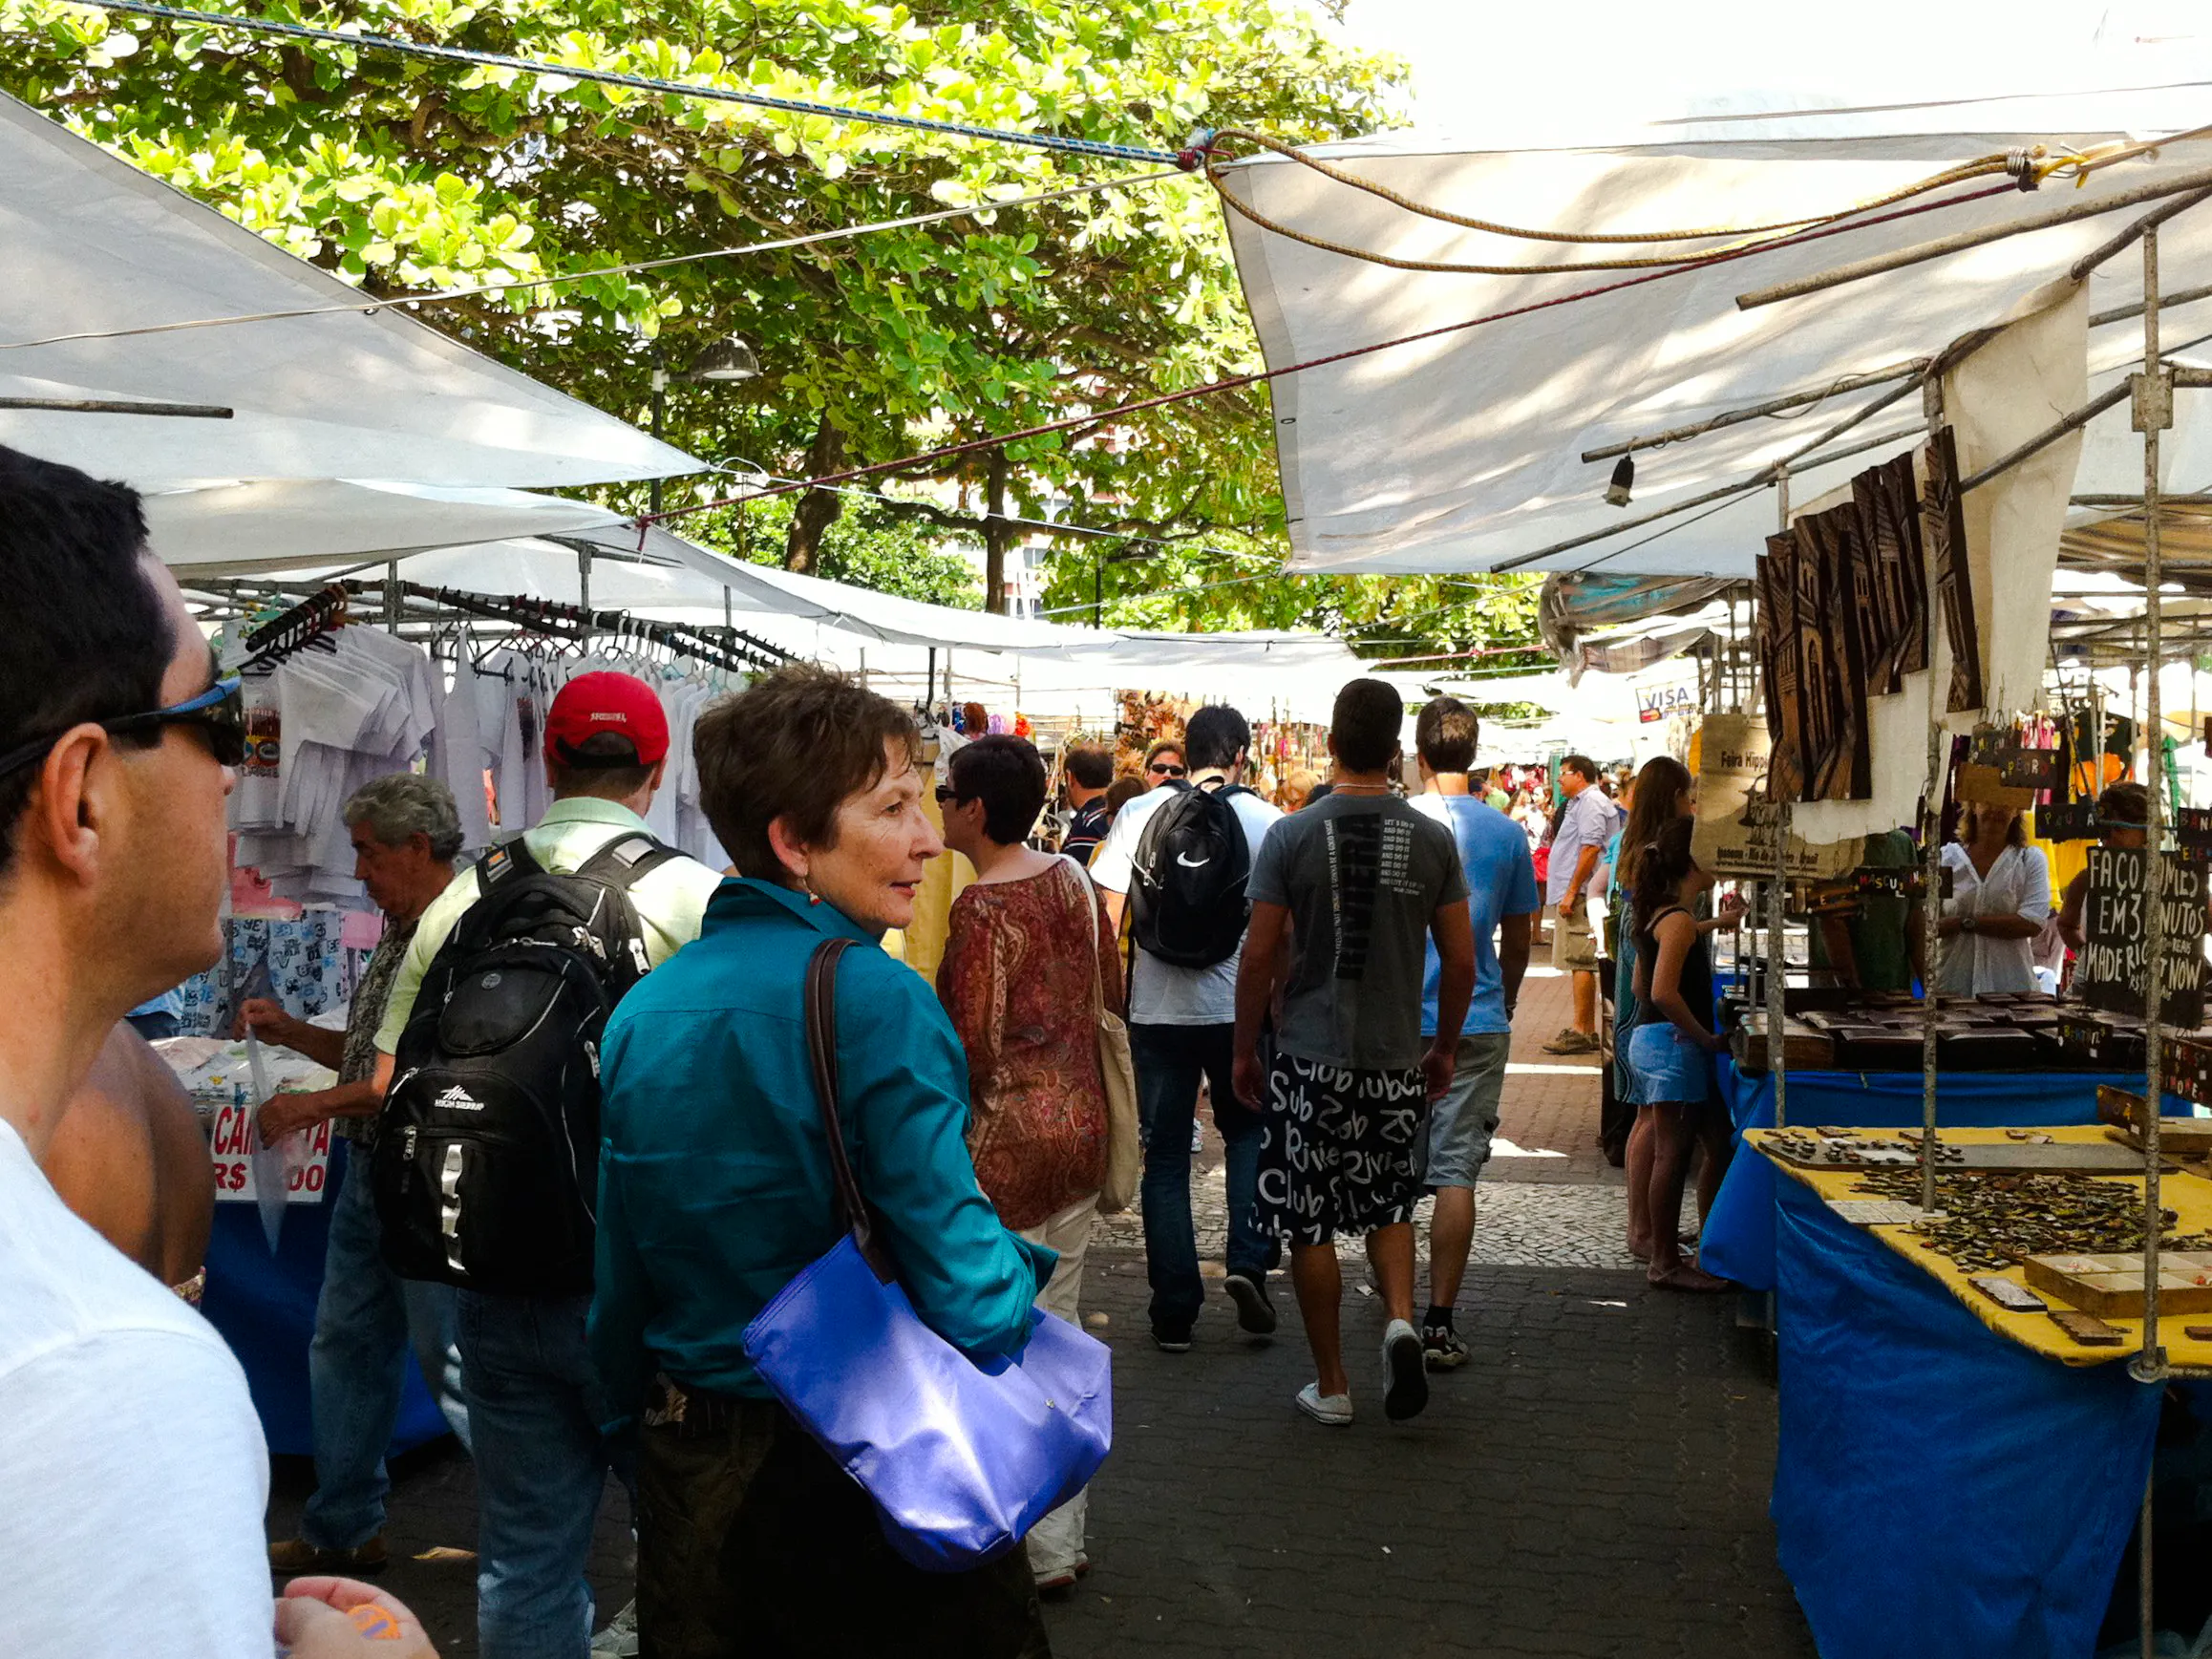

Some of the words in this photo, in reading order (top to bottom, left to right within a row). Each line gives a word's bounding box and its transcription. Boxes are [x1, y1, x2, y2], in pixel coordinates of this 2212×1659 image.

[1646, 687, 1689, 710] VISA
[1721, 751, 1742, 769] Feira
[2089, 849, 2139, 898] FAÇO
[2085, 941, 2123, 984] MADE
[2168, 956, 2202, 991] NOW
[1270, 1070, 1313, 1122] Sub
[213, 1161, 247, 1193] R$
[1258, 1168, 1326, 1219] Club
